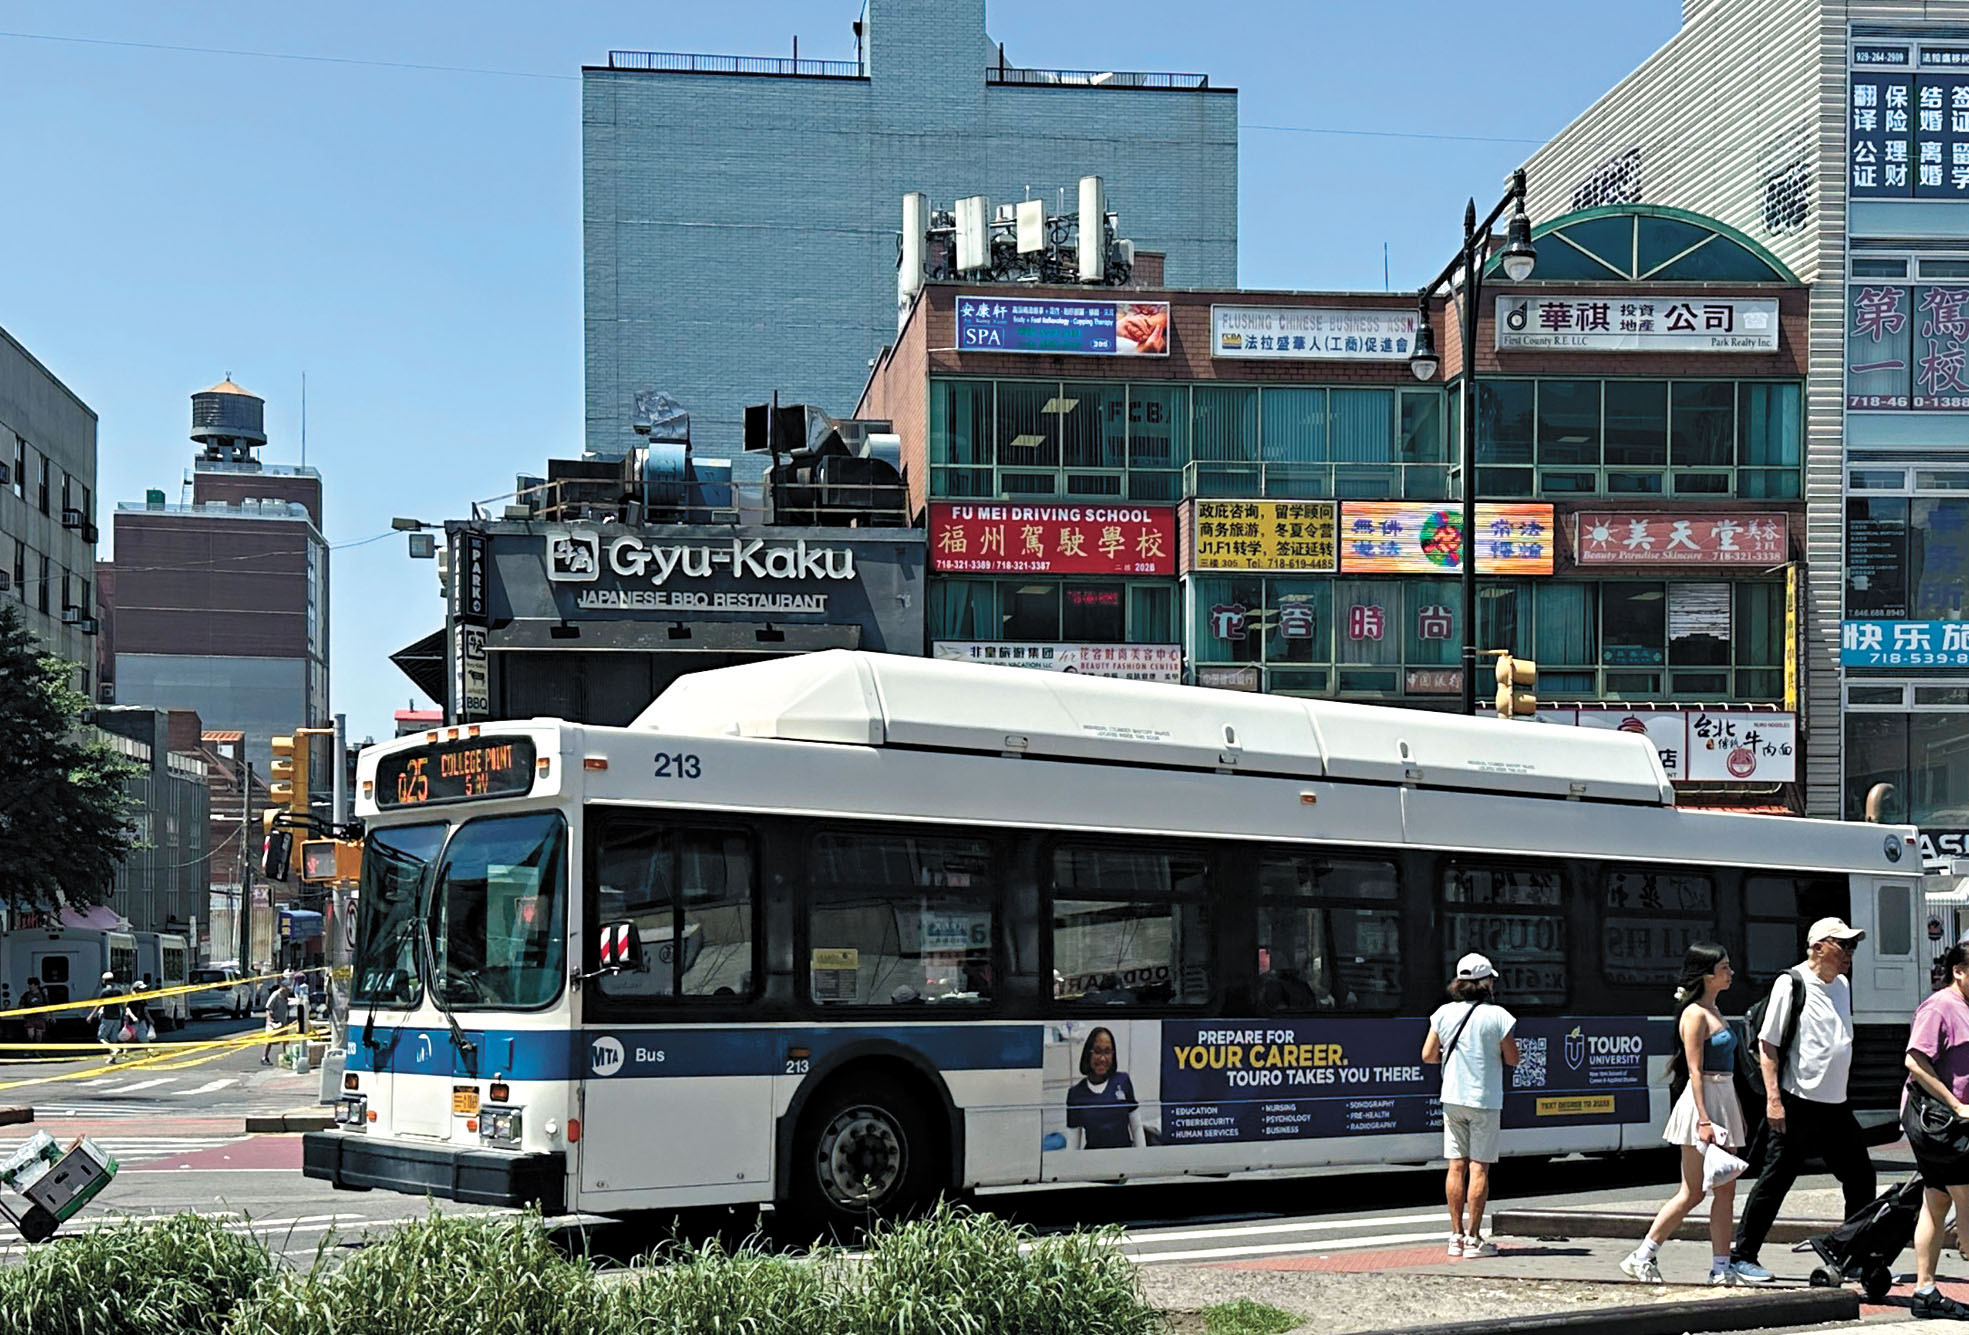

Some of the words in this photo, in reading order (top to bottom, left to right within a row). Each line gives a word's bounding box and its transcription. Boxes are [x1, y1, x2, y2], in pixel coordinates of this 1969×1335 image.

[1853, 84, 1877, 131] 翻译
[1885, 84, 1908, 132] 保险
[1919, 86, 1943, 132] 结婚
[1853, 140, 1877, 187] 公证
[1885, 140, 1908, 187] 理财
[1919, 141, 1943, 187] 离婚
[1222, 312, 1272, 330] FLUSHING
[1279, 315, 1323, 331] CHINESE
[1330, 316, 1379, 332] BUSINESS
[1664, 303, 1735, 333] 公司
[966, 328, 1001, 345] SPA
[1850, 286, 1906, 374] 第一
[1523, 336, 1552, 348] County
[1572, 337, 1588, 346] LLC
[1711, 338, 1729, 347] Park
[1730, 337, 1757, 348] Realty
[1758, 338, 1773, 347] Inc.
[952, 506, 973, 520] FU
[978, 507, 1007, 521] MEI
[1012, 508, 1081, 522] DRIVING
[1085, 509, 1152, 523] SCHOOL
[1275, 504, 1334, 519] 留学顾问
[1275, 522, 1334, 538] 冬夏令营
[1623, 518, 1744, 550] 美天堂
[1744, 518, 1780, 540] 美容
[937, 523, 1167, 559] 福州駕駛學校
[608, 536, 857, 586] Gyu-Kaku
[1583, 551, 1617, 561] Beauty
[1618, 551, 1660, 561] Paradise
[1662, 551, 1703, 561] Skincare
[472, 549, 481, 599] PARK
[578, 590, 667, 609] JAPANESE
[671, 592, 709, 609] BBQ
[713, 593, 828, 611] RESTAURANT
[1081, 662, 1109, 670] BEAUTY
[1113, 662, 1147, 670] FASHION
[467, 696, 487, 710] BBQ
[441, 749, 482, 777] COLLEGE
[485, 744, 512, 771] POINT
[654, 753, 701, 779] 213
[465, 774, 473, 797] 5
[1198, 1030, 1263, 1045] PREPARE
[1266, 1030, 1294, 1044] FOR
[1588, 1036, 1642, 1054] TOURO
[636, 1048, 665, 1062] Bus
[1174, 1045, 1241, 1069] YOUR
[1250, 1044, 1349, 1067] CAREER.
[1589, 1054, 1641, 1065] UNIVERSITY
[785, 1060, 809, 1074] 213
[1227, 1070, 1283, 1087] TOURO
[1286, 1068, 1335, 1085] TAKES
[1338, 1068, 1371, 1083] YOU
[1373, 1066, 1424, 1082] THERE.
[1176, 1106, 1218, 1115] EDUCATION
[1266, 1104, 1296, 1112] NURSING
[1350, 1100, 1395, 1109] SONOGRAPHY
[1176, 1117, 1235, 1127] CYBERSECURITY
[1266, 1114, 1312, 1123] PSYCHOLOGY
[1350, 1110, 1390, 1119] PRE-HEALTH
[1176, 1129, 1204, 1138] HUMAN
[1204, 1128, 1239, 1137] SERVICES
[1266, 1125, 1299, 1134] BUSINESS
[1350, 1121, 1397, 1130] RADIOGRAPHY
